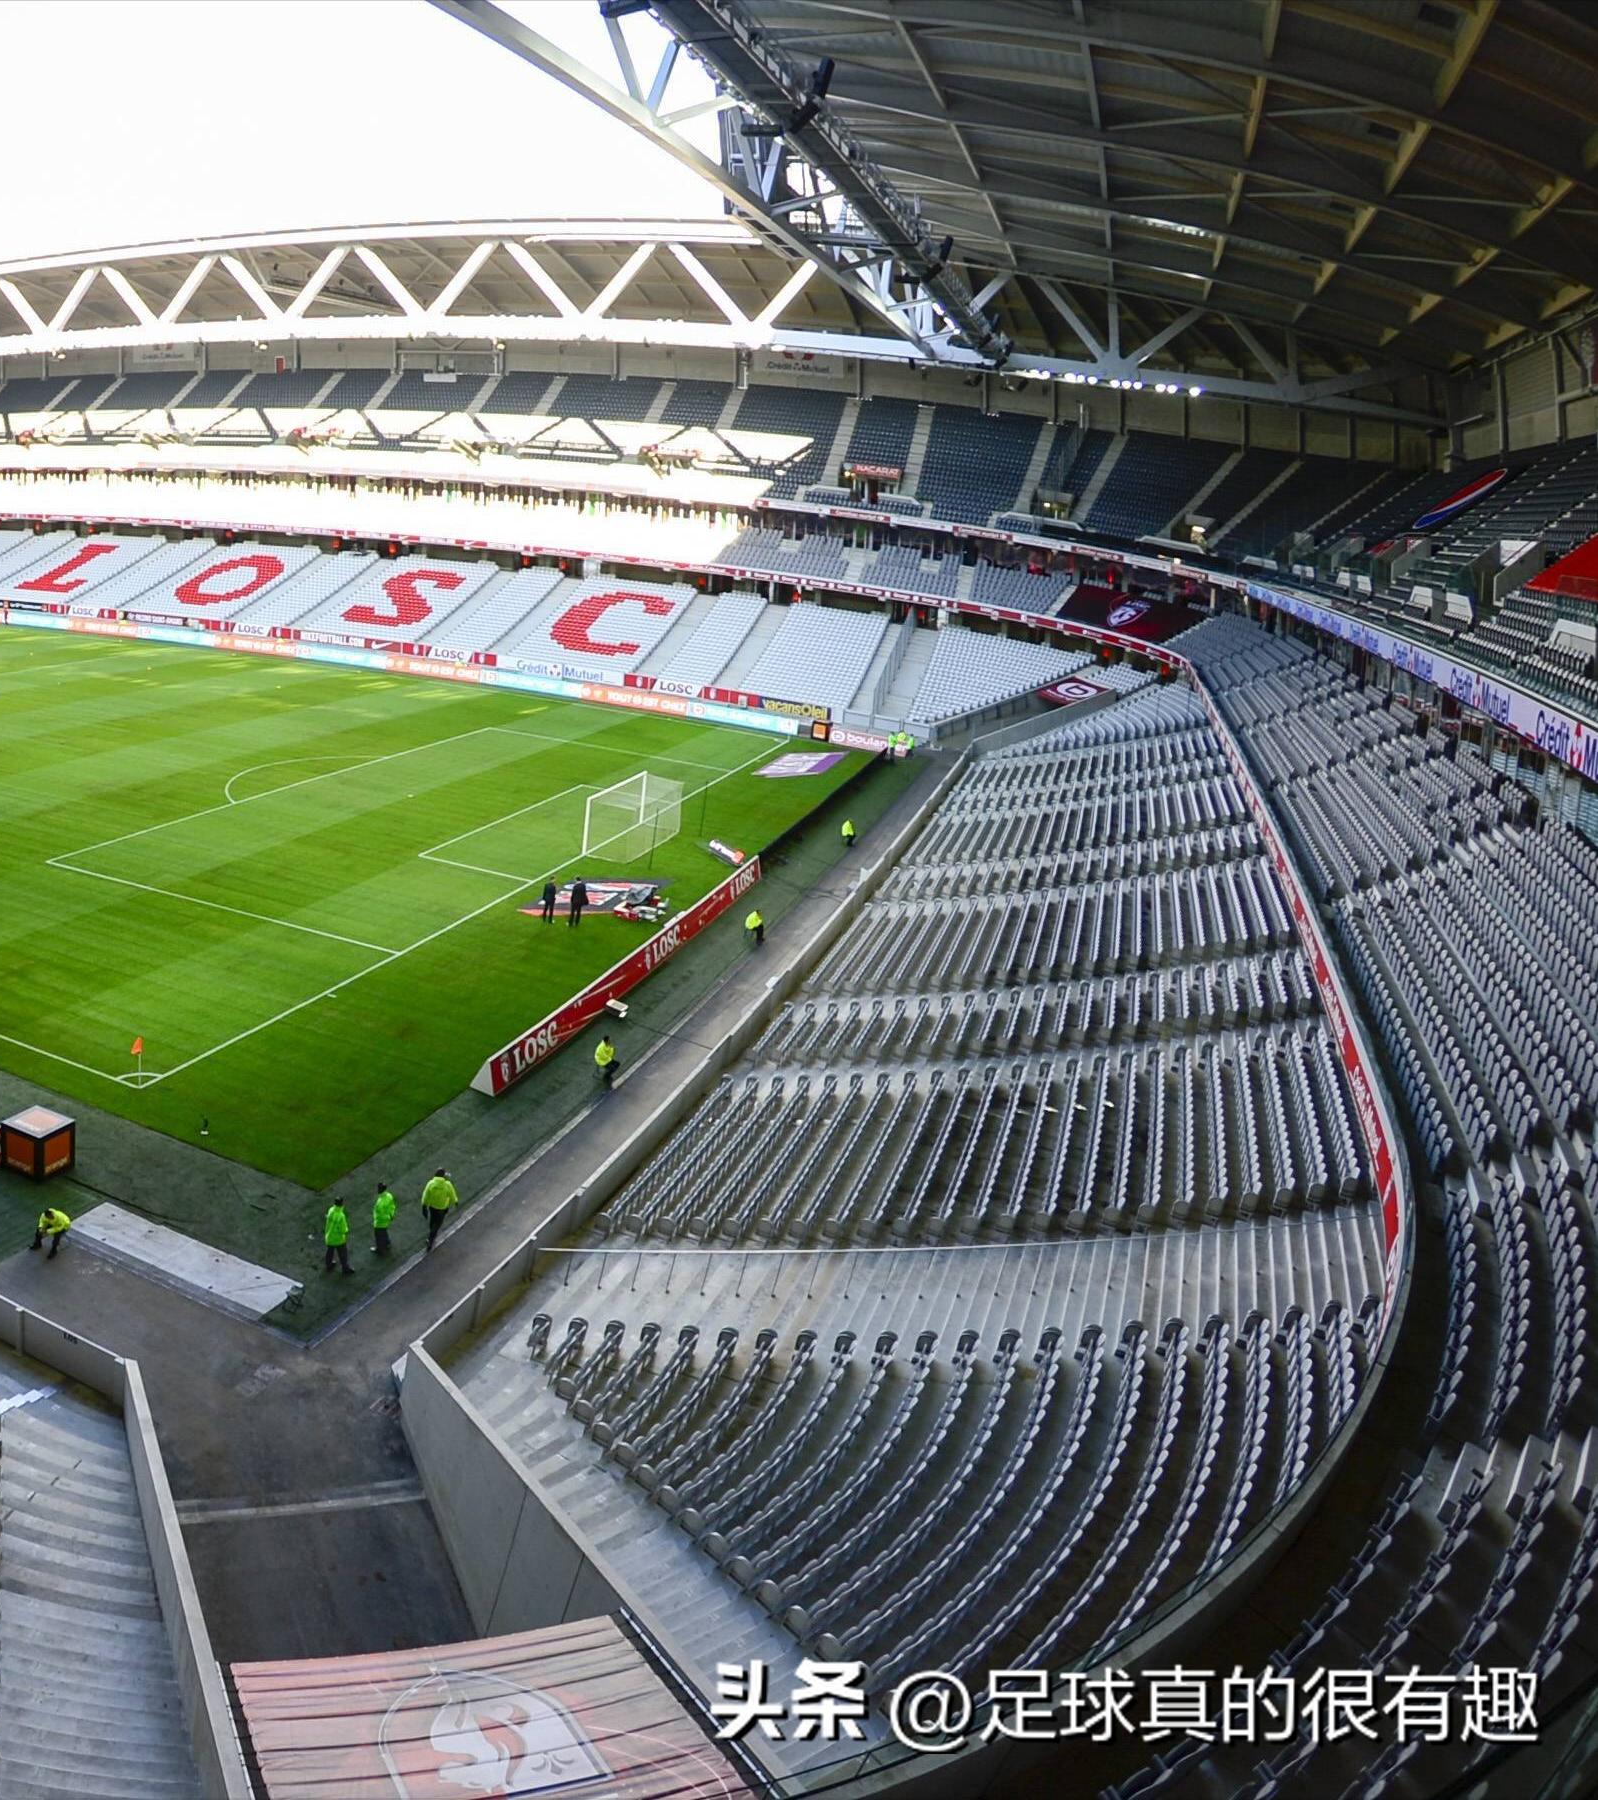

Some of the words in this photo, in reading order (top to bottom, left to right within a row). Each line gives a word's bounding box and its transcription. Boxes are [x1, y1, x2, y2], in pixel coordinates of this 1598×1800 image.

[71, 606, 93, 617] LOSC
[237, 623, 264, 635] LOSC
[433, 648, 465, 660] LOSC
[516, 659, 548, 674] Crédit
[564, 666, 604, 682] Mutuel
[659, 680, 693, 695] LOSC
[1451, 667, 1473, 701] Crédit
[1479, 681, 1511, 723] Mutuel
[1536, 710, 1570, 763] Crédit
[735, 864, 755, 896] LOSC
[652, 925, 681, 964] LOSC
[513, 1020, 559, 1075] LOSC
